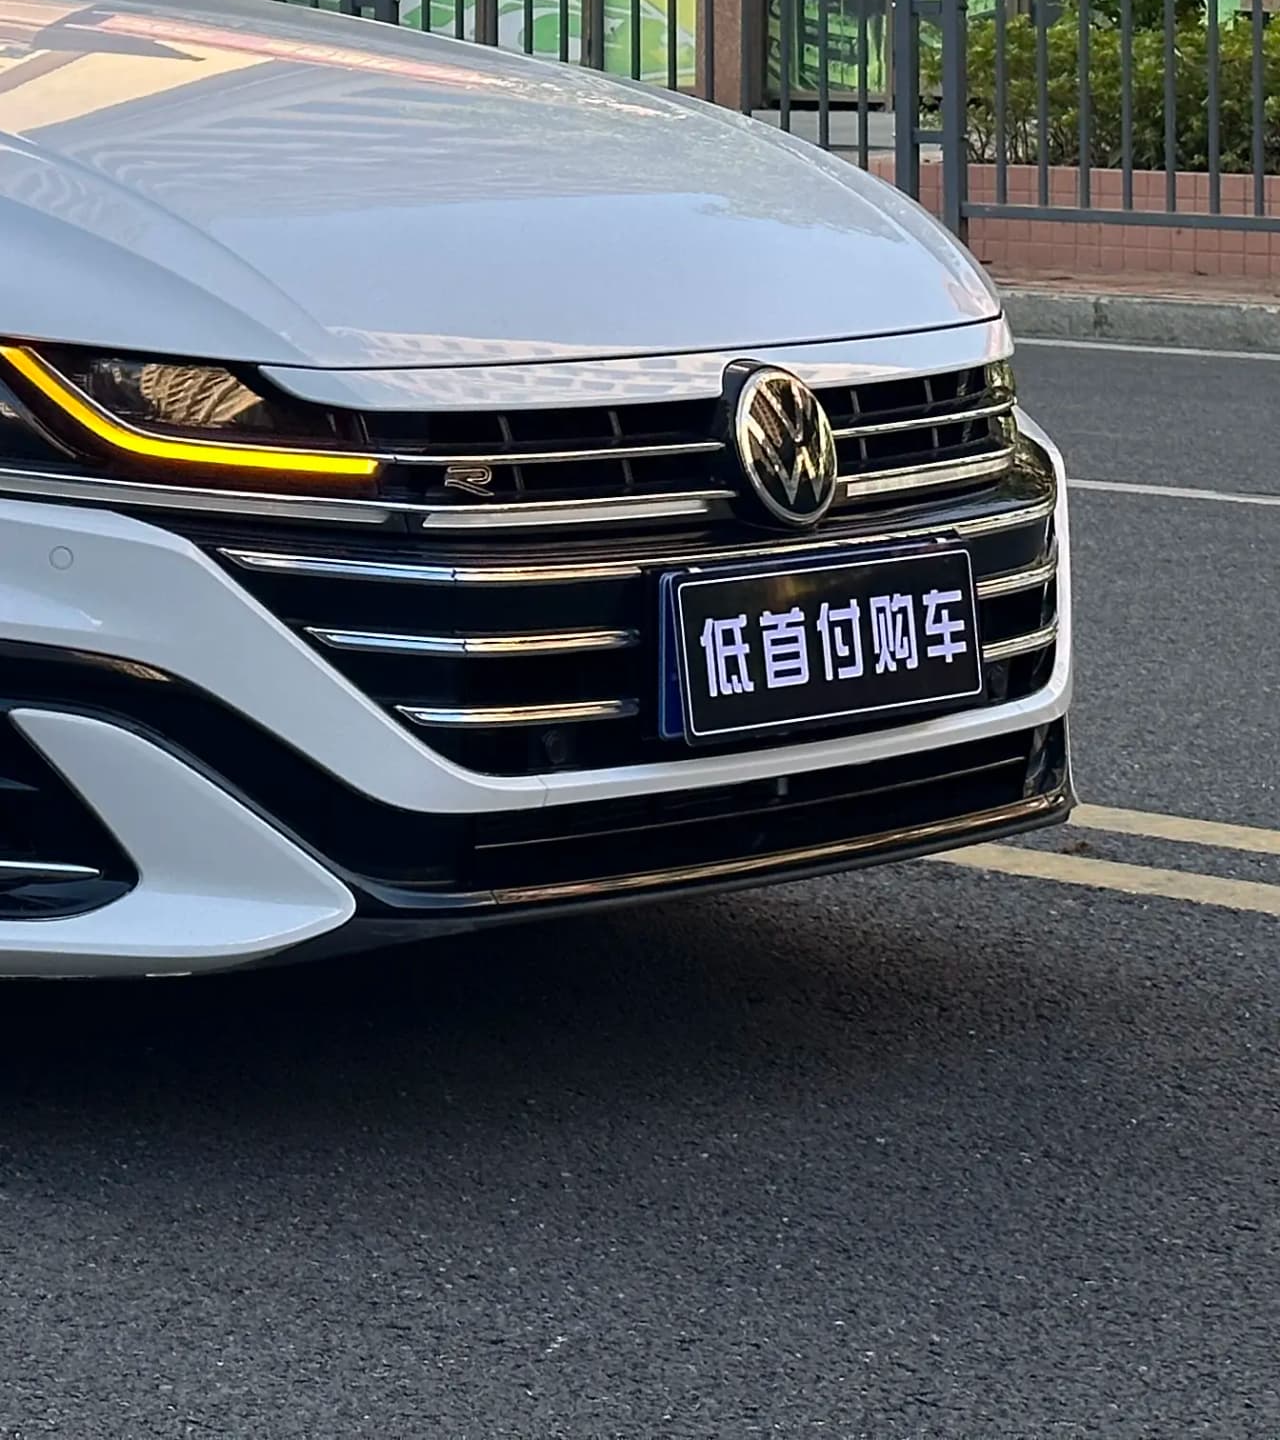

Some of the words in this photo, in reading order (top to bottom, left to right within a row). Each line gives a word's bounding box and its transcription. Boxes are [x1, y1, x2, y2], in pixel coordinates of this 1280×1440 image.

[699, 588, 969, 698] 低首付购车
